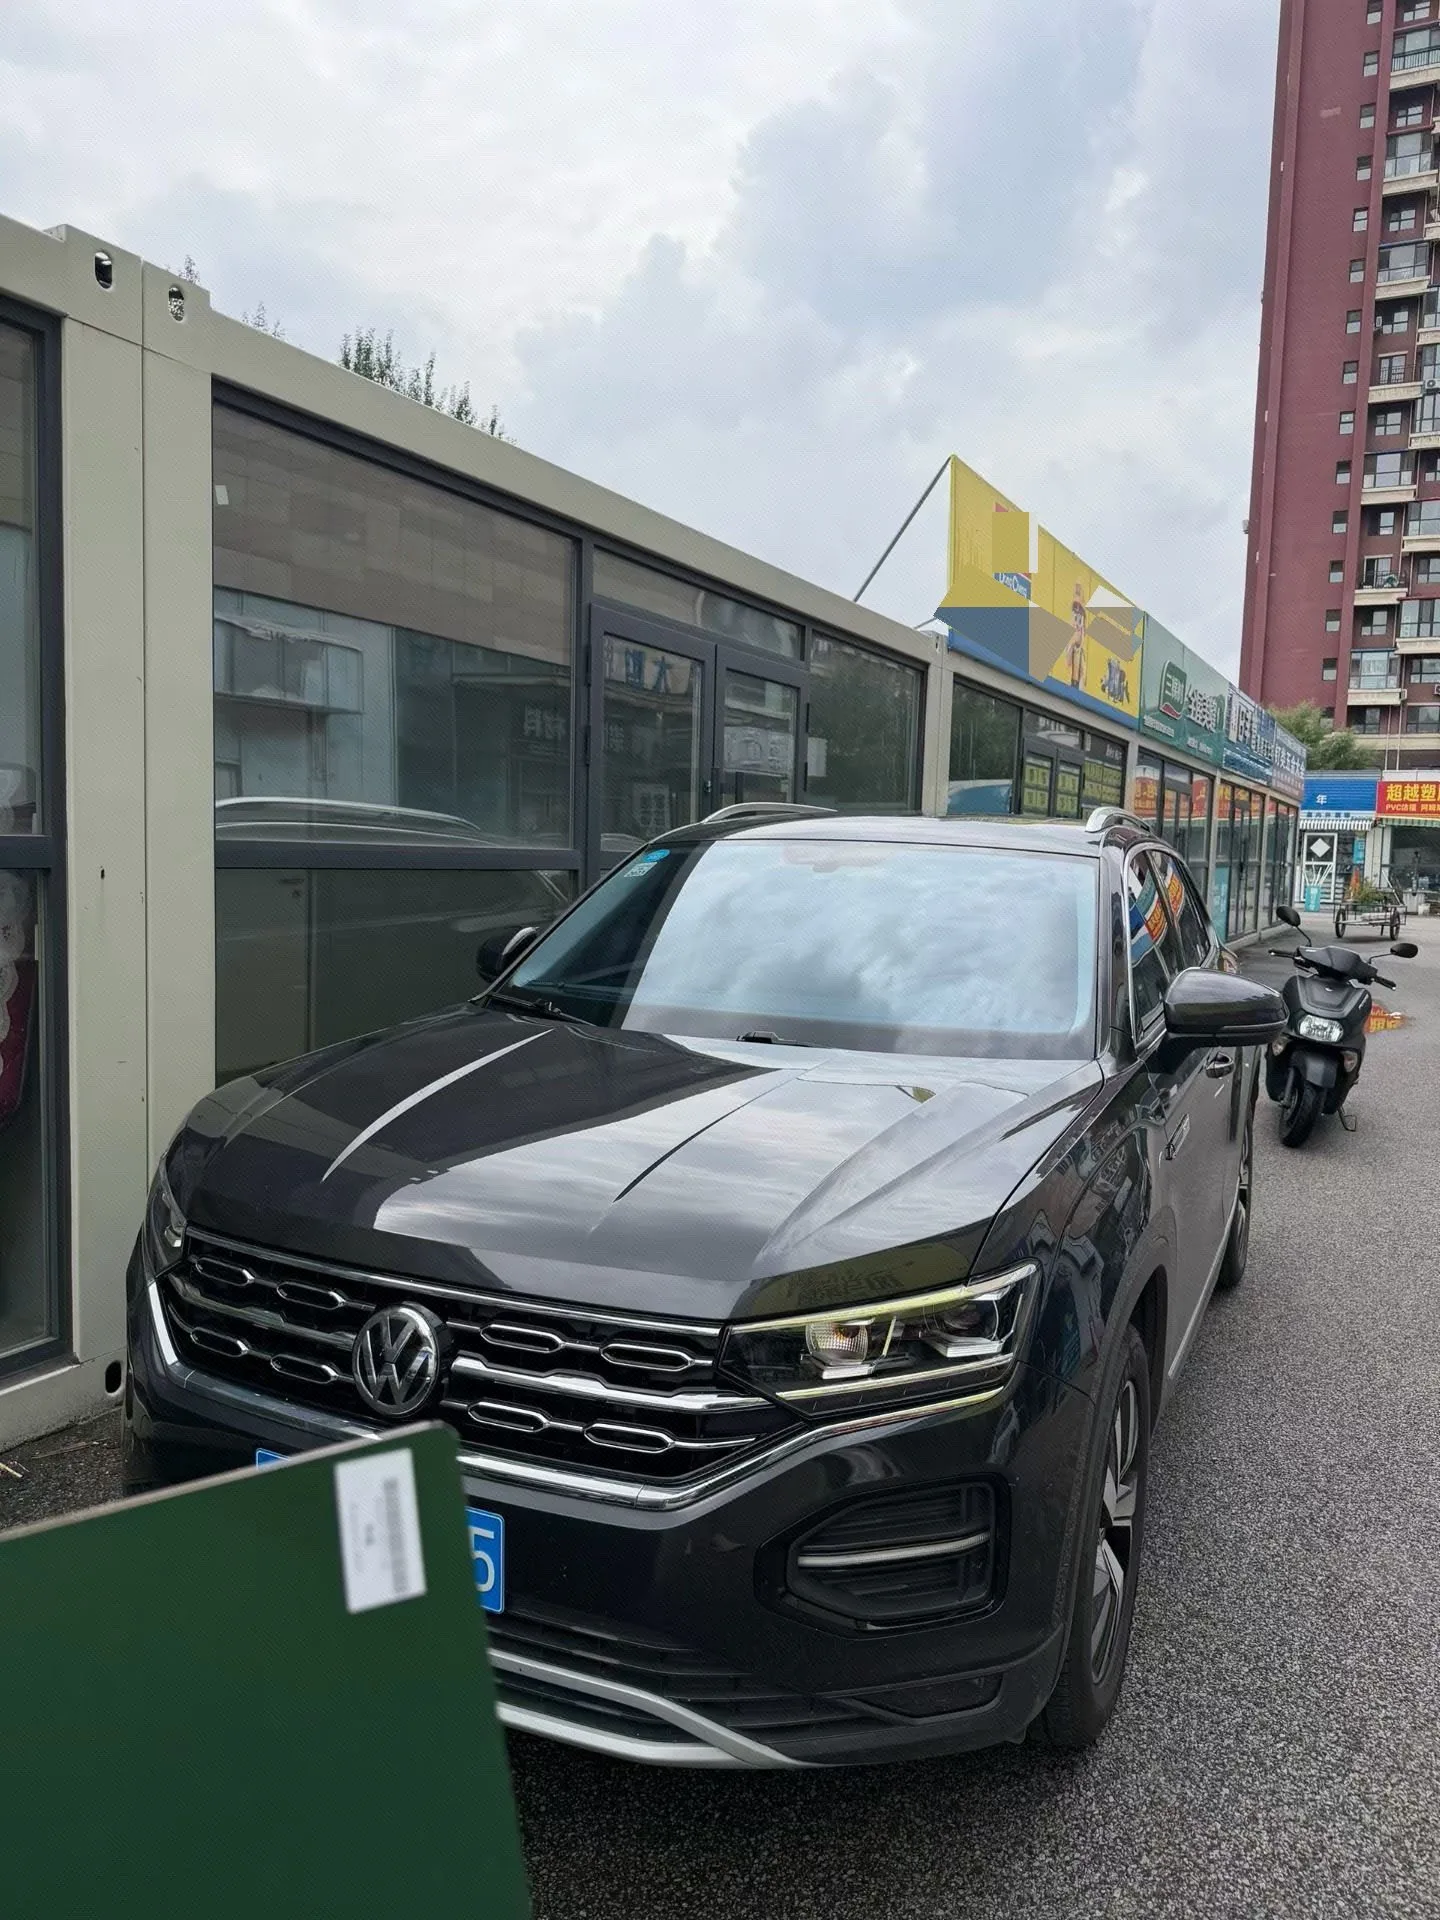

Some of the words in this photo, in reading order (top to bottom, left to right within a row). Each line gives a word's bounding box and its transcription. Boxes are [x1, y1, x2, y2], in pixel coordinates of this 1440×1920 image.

[1387, 783, 1440, 801] 超越塑
[1316, 795, 1327, 805] 年
